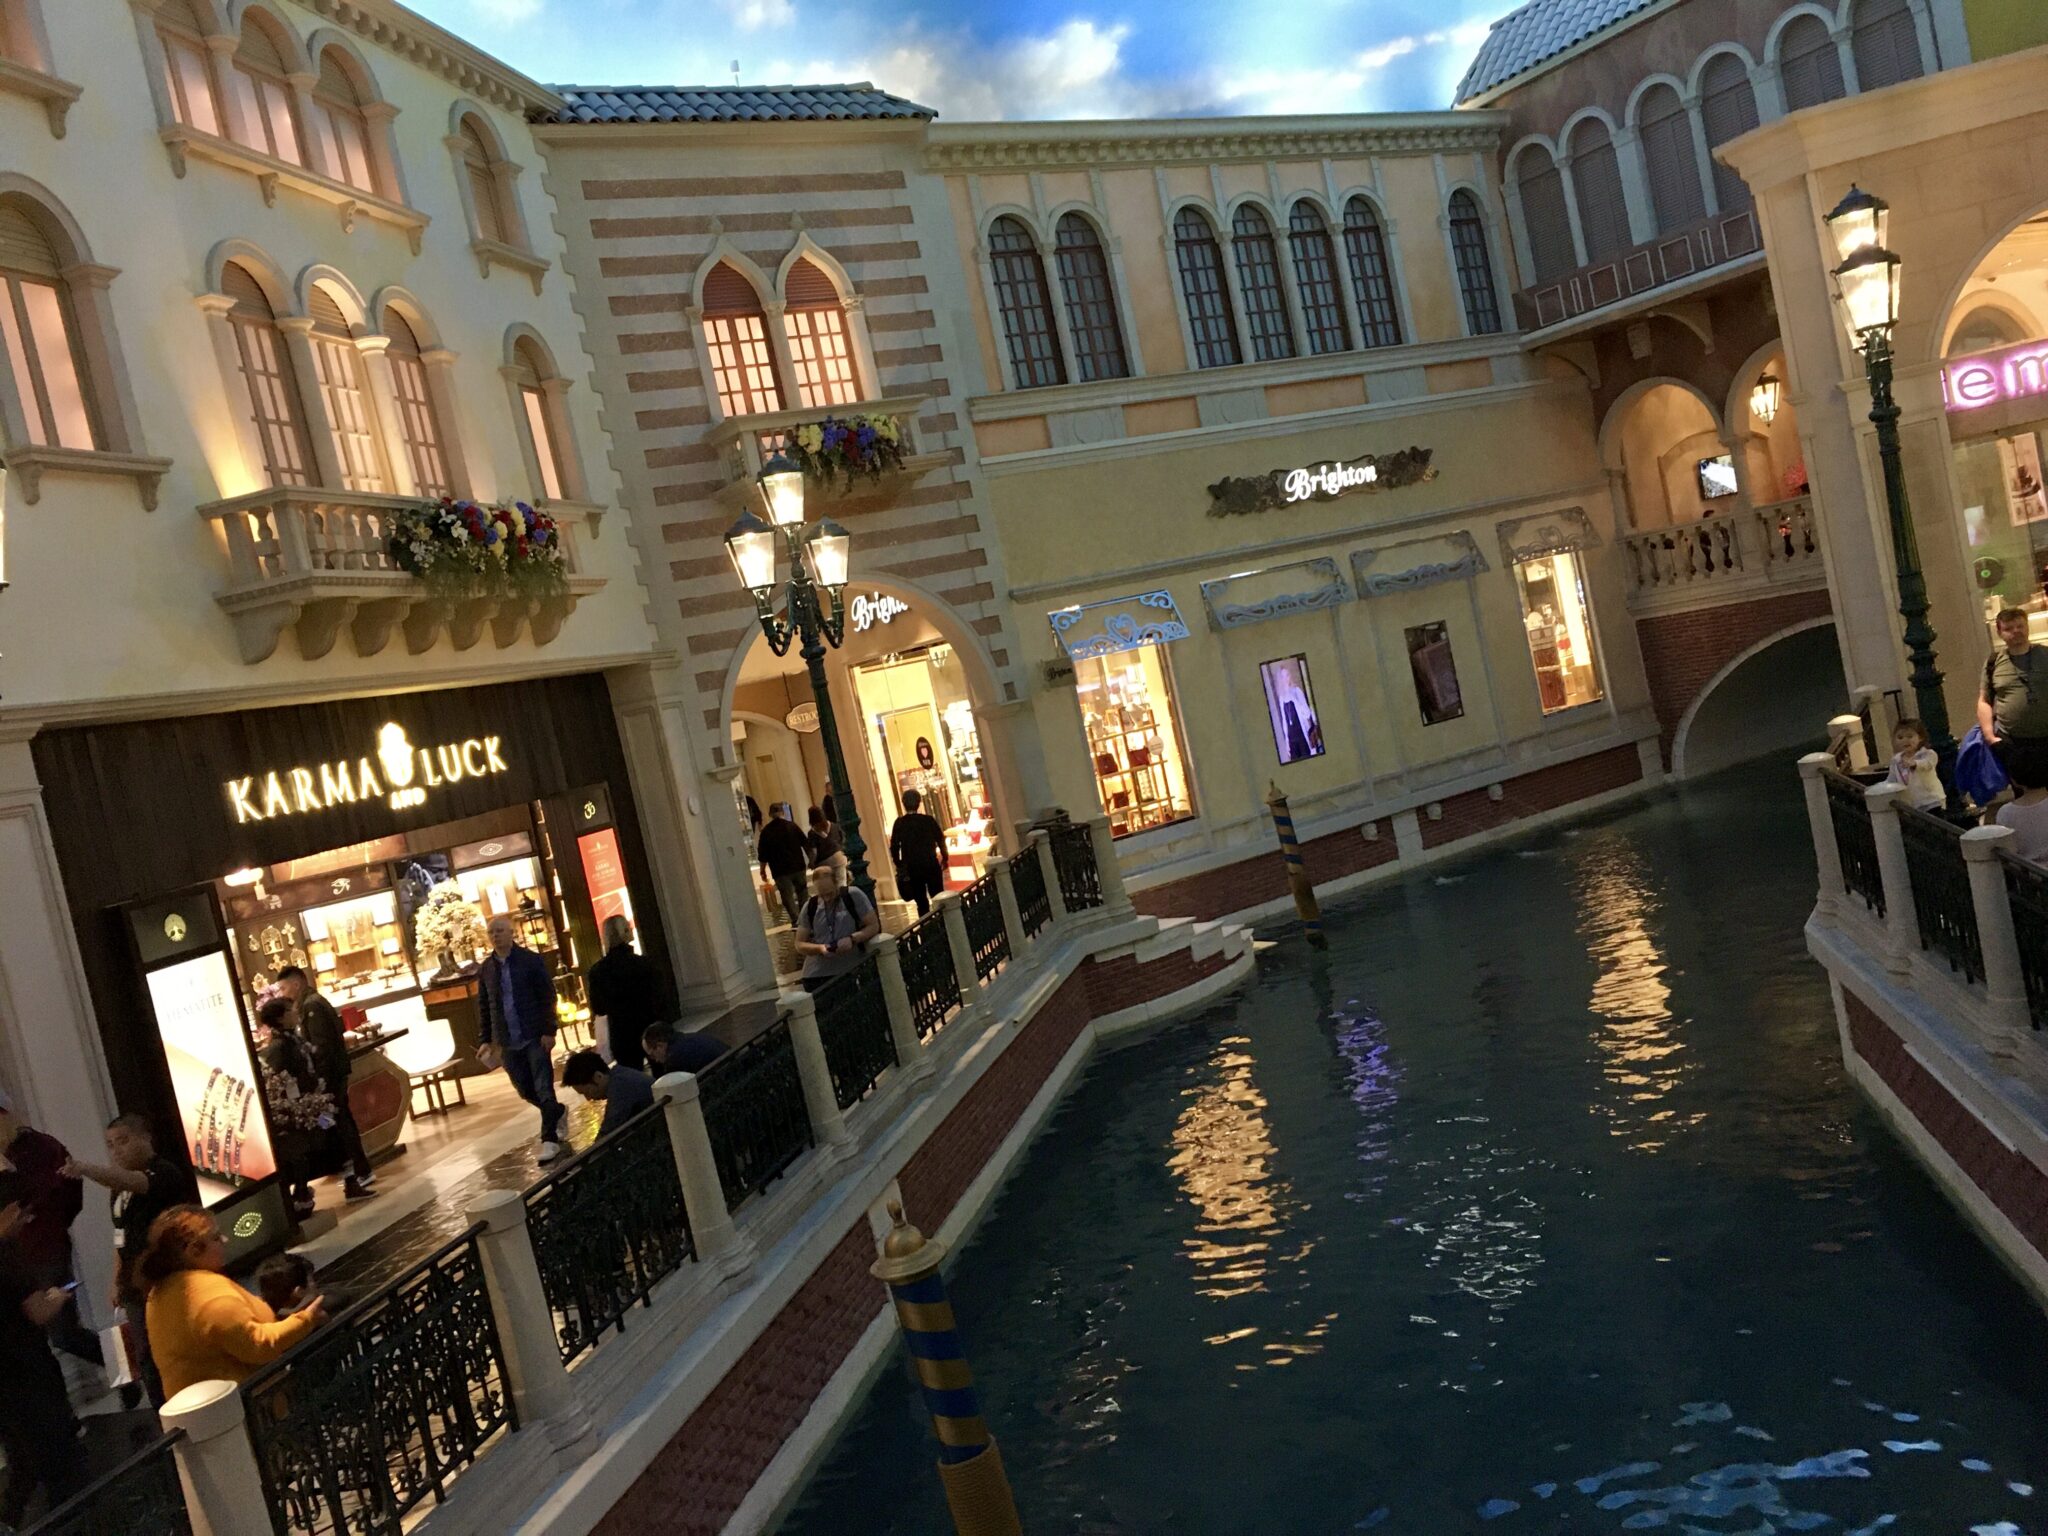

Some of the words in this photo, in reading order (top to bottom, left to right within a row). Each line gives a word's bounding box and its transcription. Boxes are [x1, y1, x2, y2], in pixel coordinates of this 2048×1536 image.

[1285, 462, 1378, 502] Brighton
[226, 757, 384, 824] KARMA
[420, 736, 508, 786] LUCK
[390, 787, 427, 810] AND
